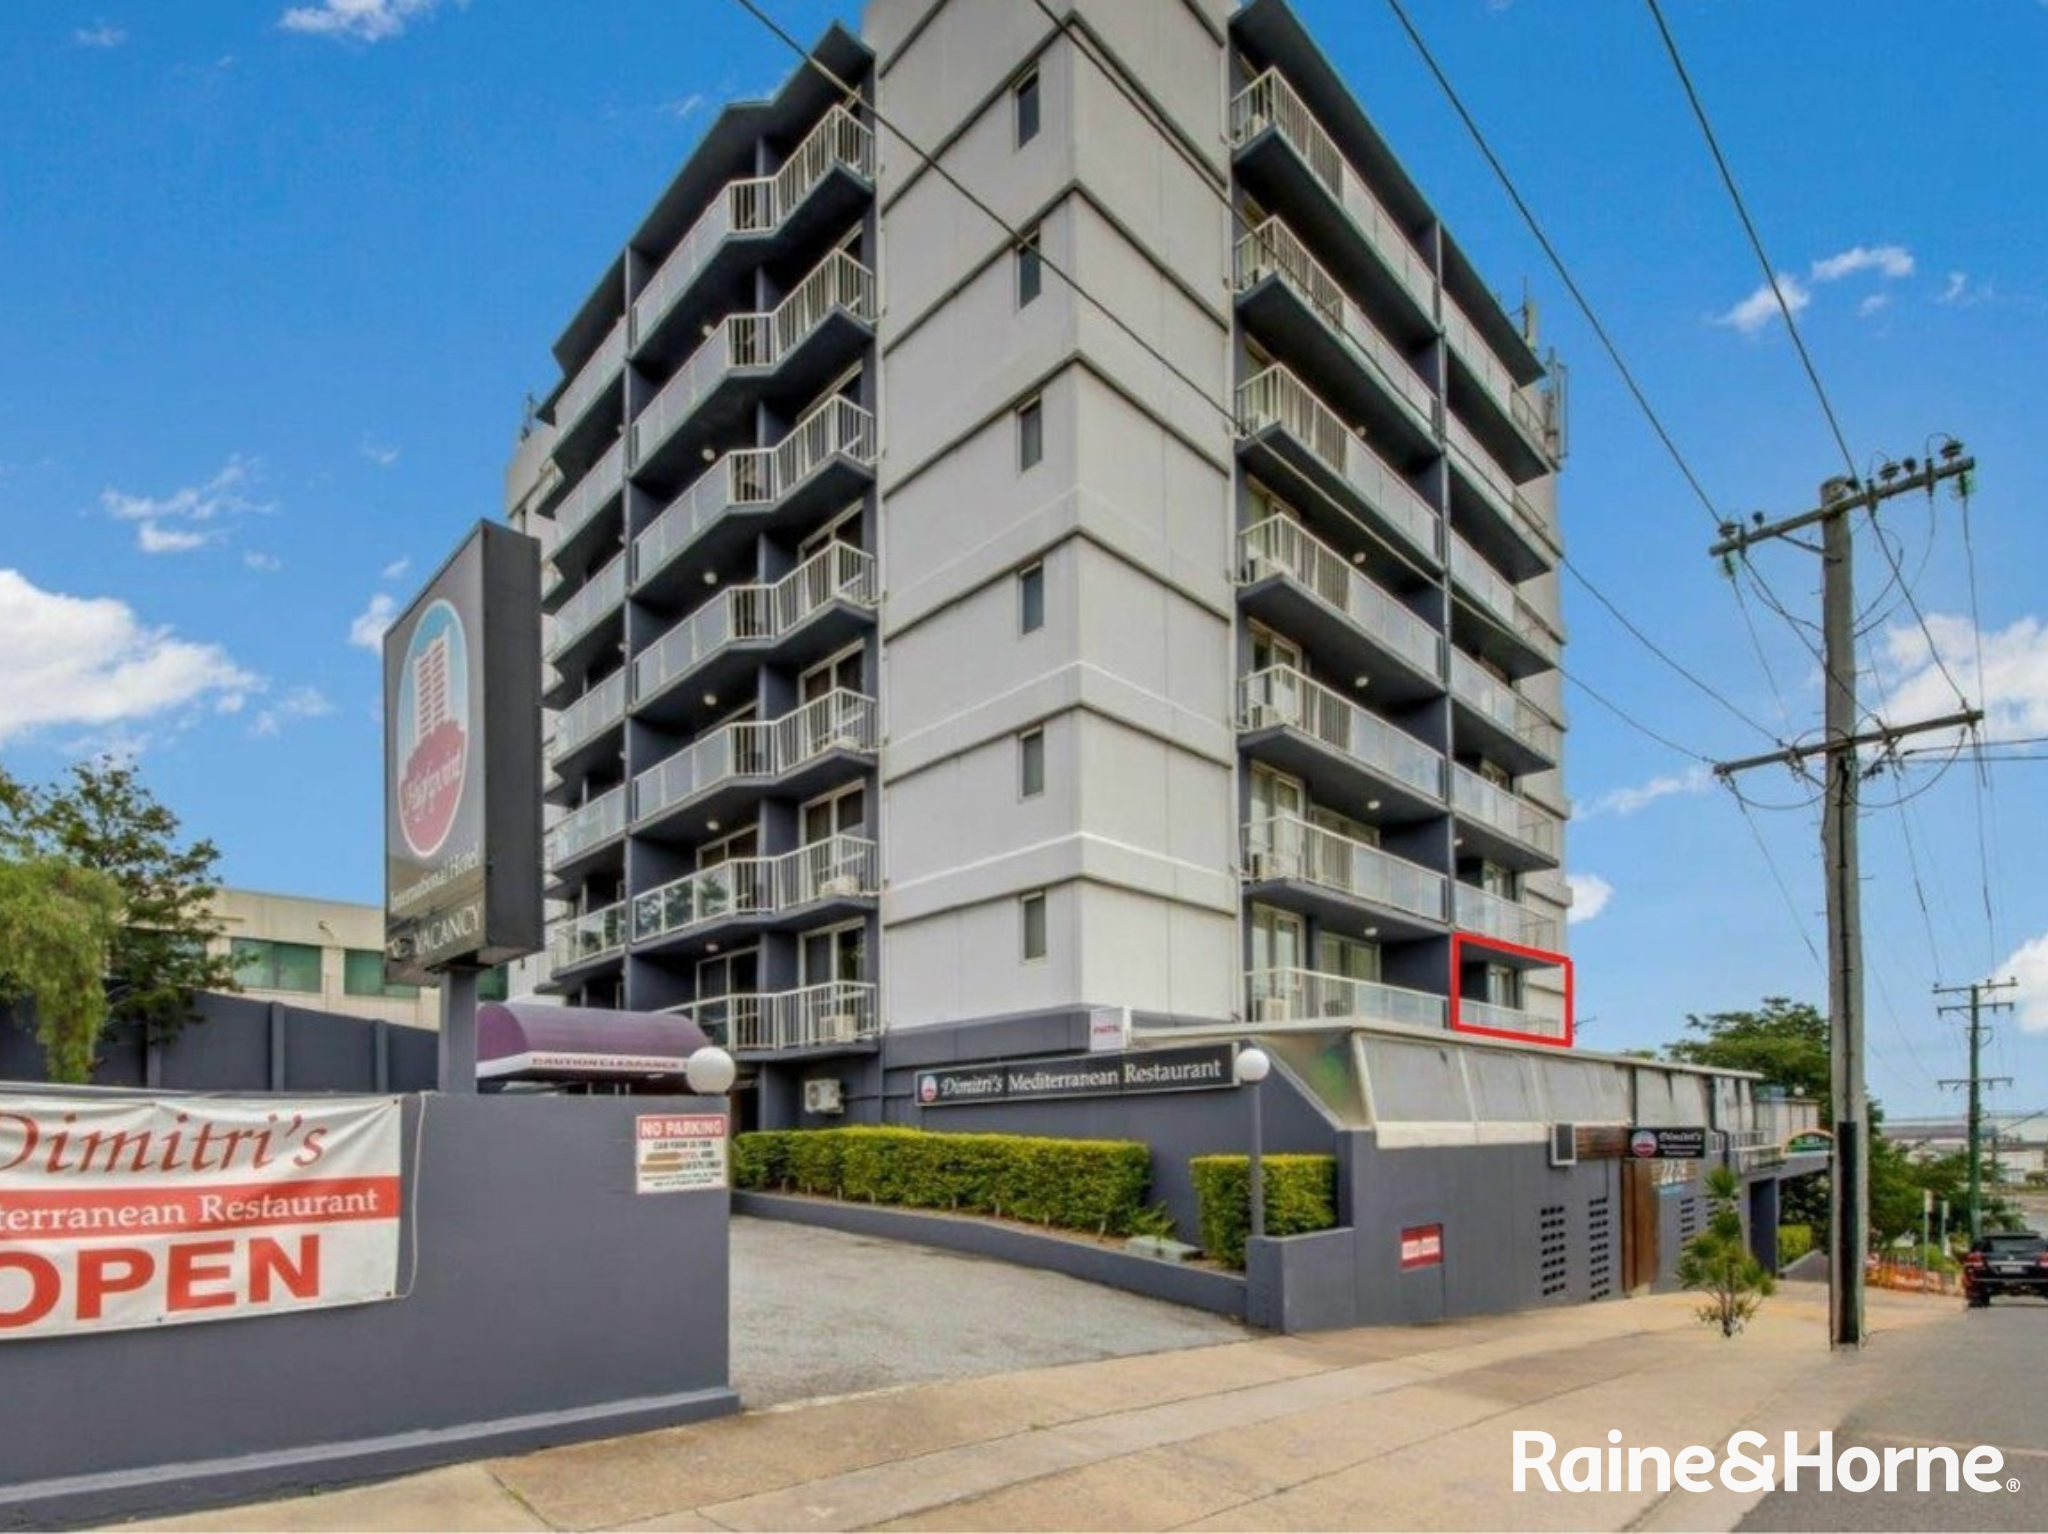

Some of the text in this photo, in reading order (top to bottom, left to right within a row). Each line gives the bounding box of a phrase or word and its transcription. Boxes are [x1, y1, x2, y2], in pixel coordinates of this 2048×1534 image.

[449, 841, 480, 879] Hotel
[413, 901, 482, 956] VACANCY
[940, 1060, 1221, 1096] Dimitri's Mediterranean Restaurant
[641, 1119, 722, 1137] NO PARKING
[199, 1189, 379, 1223] Restaurant
[0, 1234, 320, 1329] OPEN
